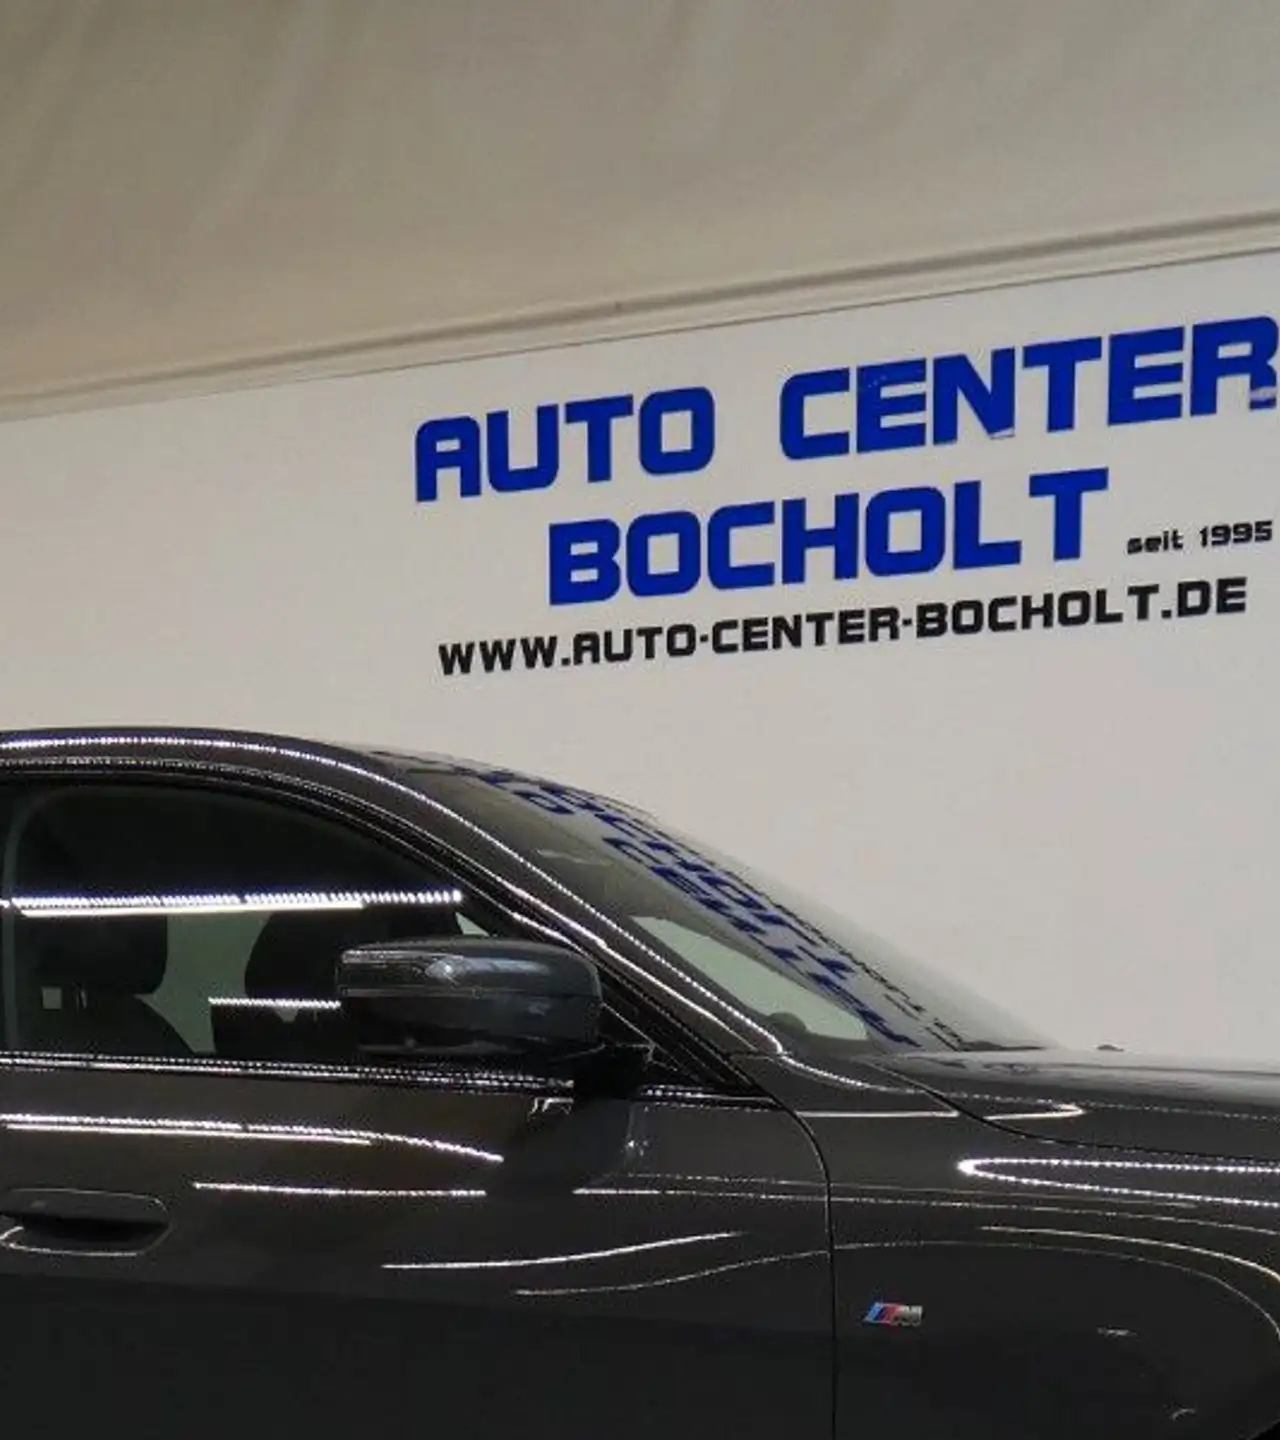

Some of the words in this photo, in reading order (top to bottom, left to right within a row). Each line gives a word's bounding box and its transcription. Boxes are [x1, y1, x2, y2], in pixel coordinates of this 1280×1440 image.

[415, 386, 718, 503] AUTO
[780, 316, 1280, 462] CENTER
[549, 467, 1111, 607] BOCHOLT
[1126, 530, 1185, 556] seit
[1198, 519, 1274, 548] 1995
[437, 576, 1248, 677] WWW.AUTO-CENTER-BOCHOLT.DE
